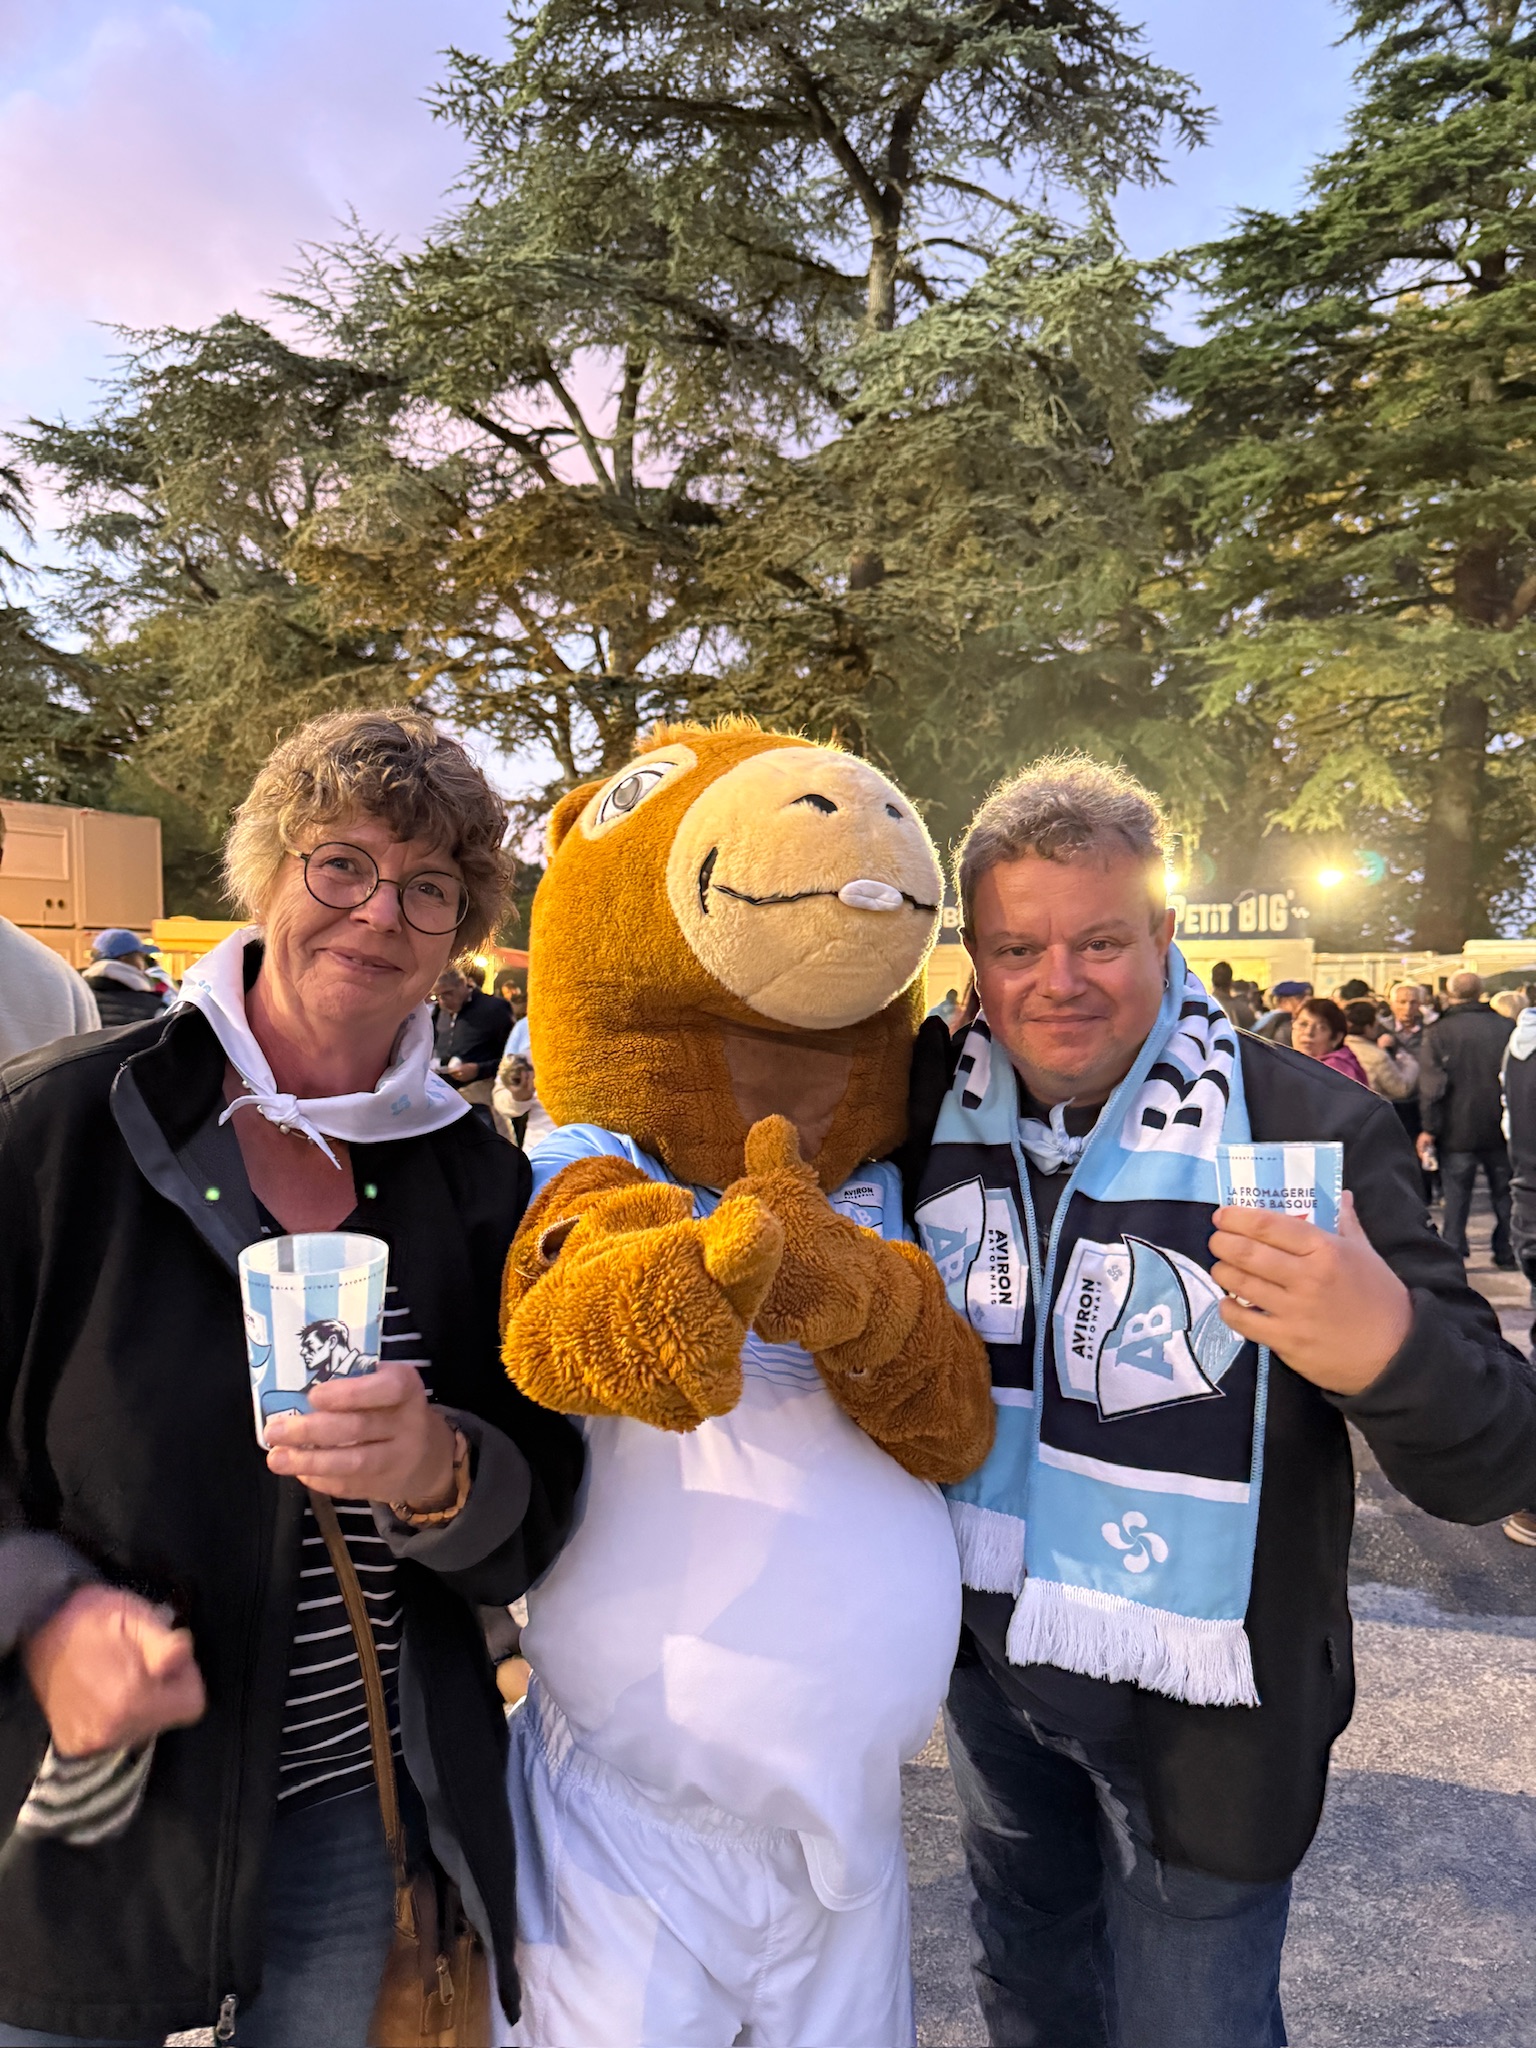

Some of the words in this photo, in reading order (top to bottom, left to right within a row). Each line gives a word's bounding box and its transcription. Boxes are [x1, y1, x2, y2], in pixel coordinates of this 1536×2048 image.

[1238, 893, 1289, 932] BIG
[844, 1186, 873, 1196] AVIRON
[1227, 1186, 1238, 1196] LA
[1240, 1187, 1316, 1198] FROMAGERIE
[1240, 1198, 1266, 1208] PAYS
[1269, 1199, 1318, 1209] BASQUE
[988, 1229, 997, 1305] BAYONNAIS
[995, 1229, 1012, 1305] AVIRON
[1071, 1278, 1095, 1358] AVIRON
[1115, 1303, 1175, 1381] AB
